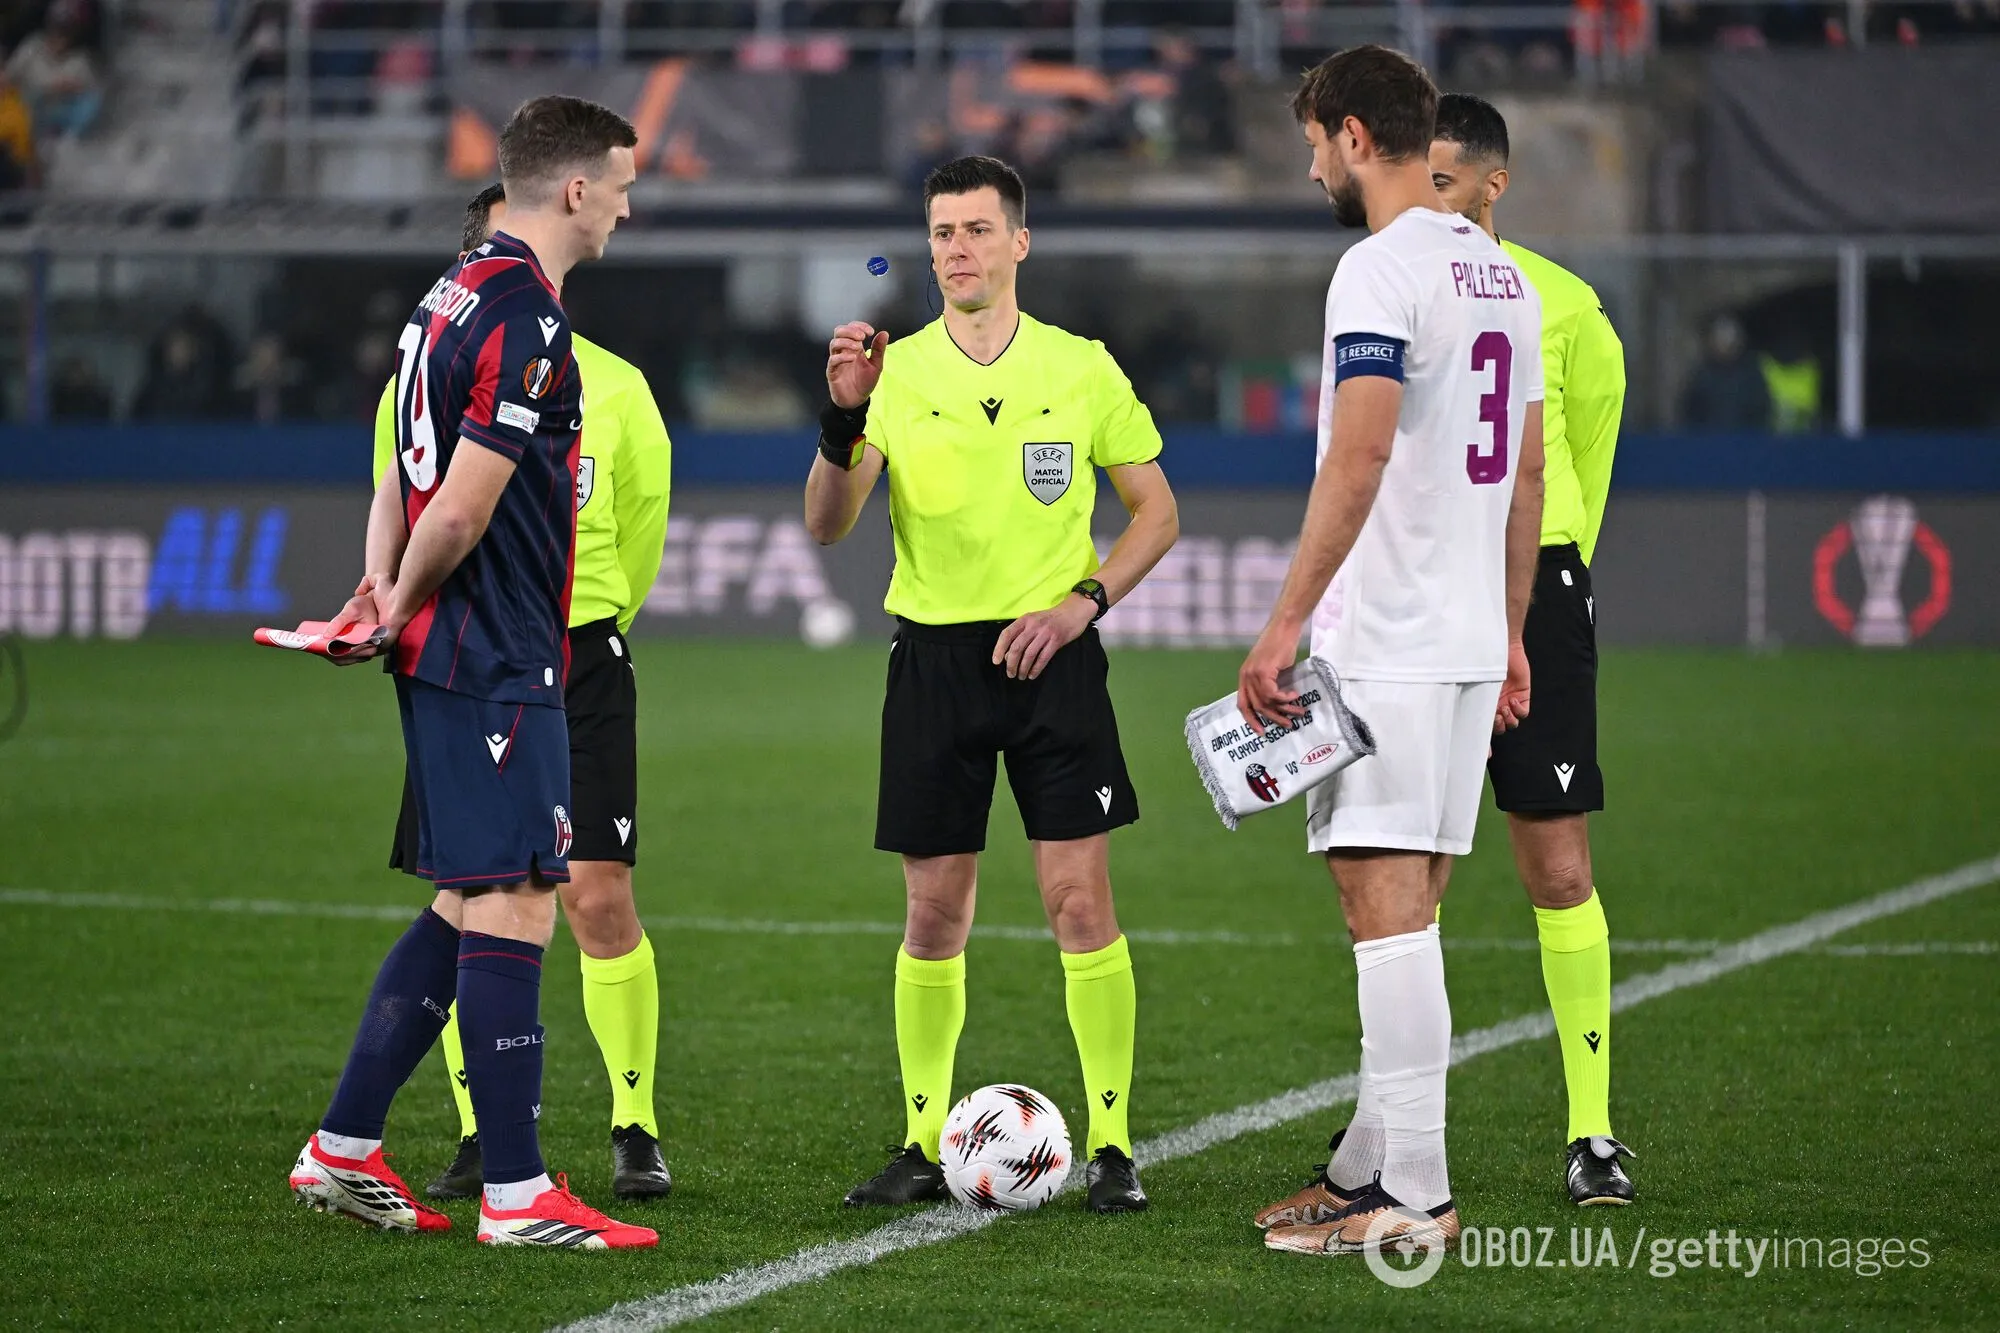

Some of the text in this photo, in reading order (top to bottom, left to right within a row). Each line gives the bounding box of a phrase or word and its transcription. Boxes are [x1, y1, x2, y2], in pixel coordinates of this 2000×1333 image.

[1348, 346, 1395, 358] RESPECT
[398, 322, 438, 492] 19
[1466, 332, 1513, 485] 3
[1033, 450, 1062, 462] UEFA
[1031, 478, 1066, 486] OFFICIAL
[1211, 728, 1241, 752] EUROPA
